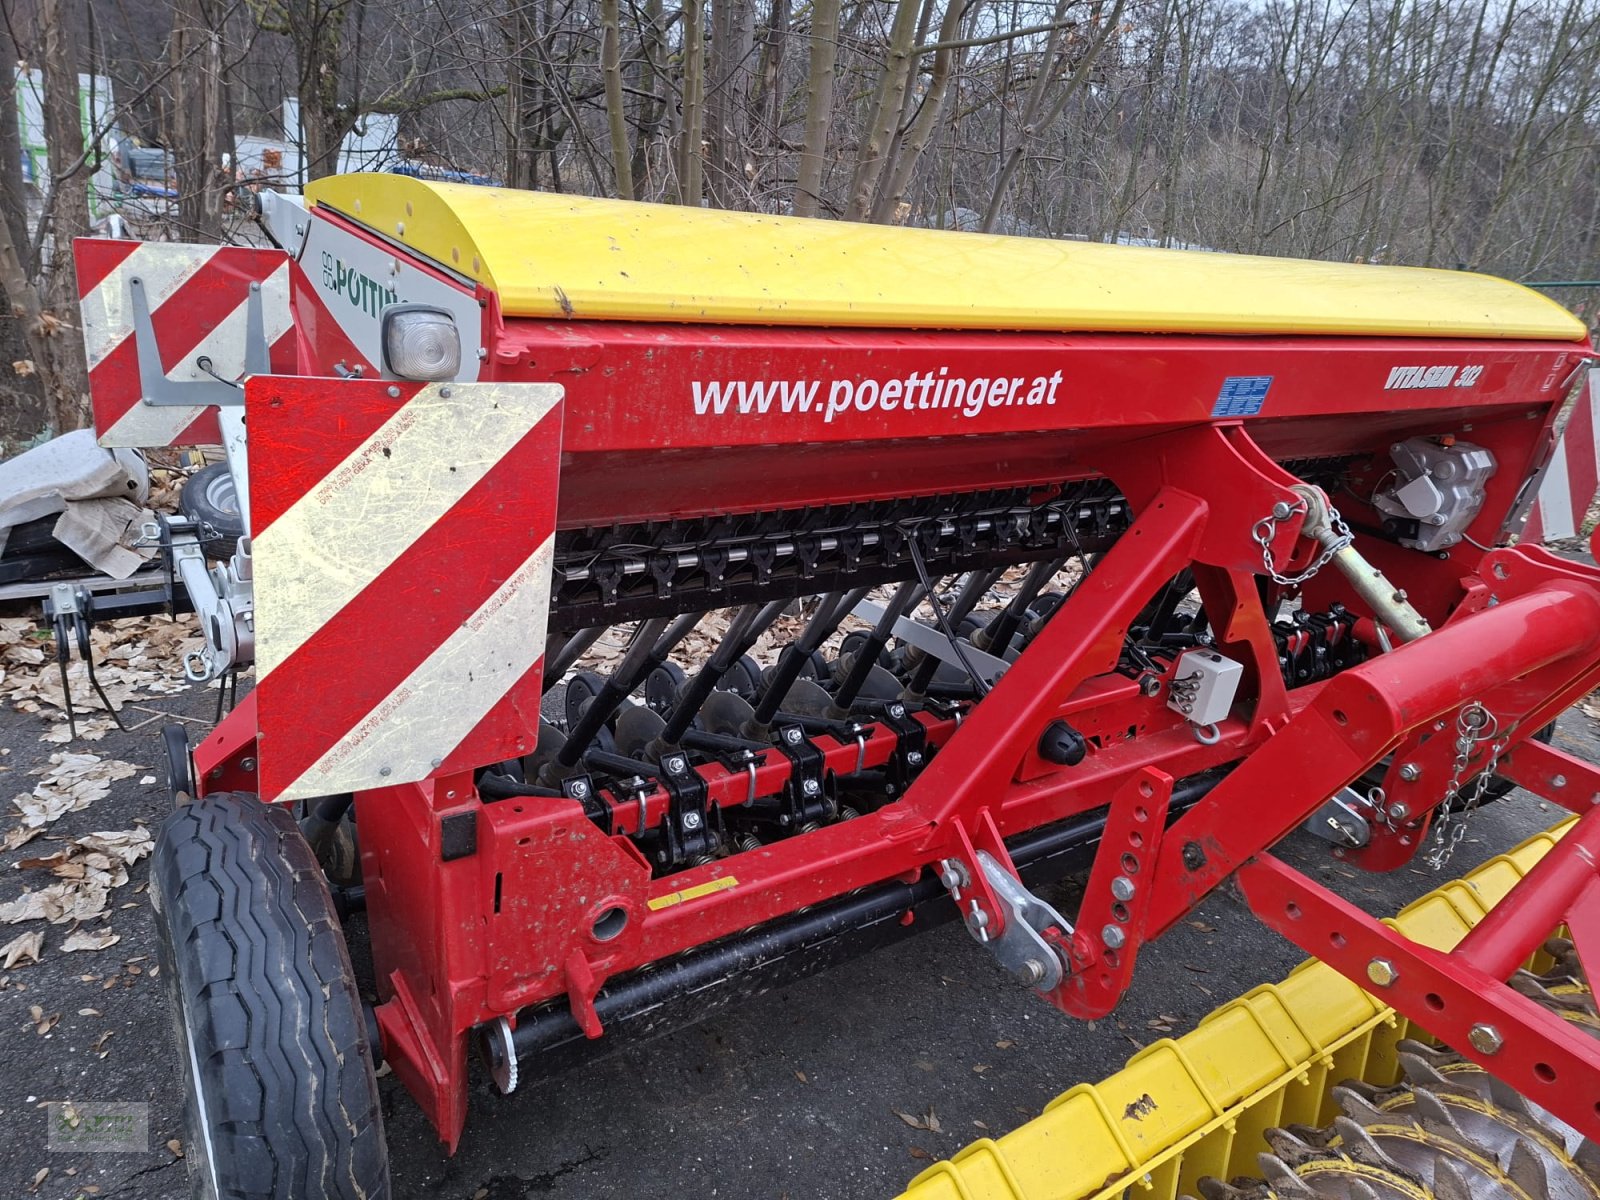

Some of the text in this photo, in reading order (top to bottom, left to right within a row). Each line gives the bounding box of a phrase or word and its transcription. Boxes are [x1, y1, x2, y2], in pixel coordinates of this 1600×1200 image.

[1384, 365, 1484, 389] VITASEM 302
[691, 366, 1063, 423] www.poettinger.at
[361, 439, 380, 458] GEKA
[352, 456, 372, 475] GEKA
